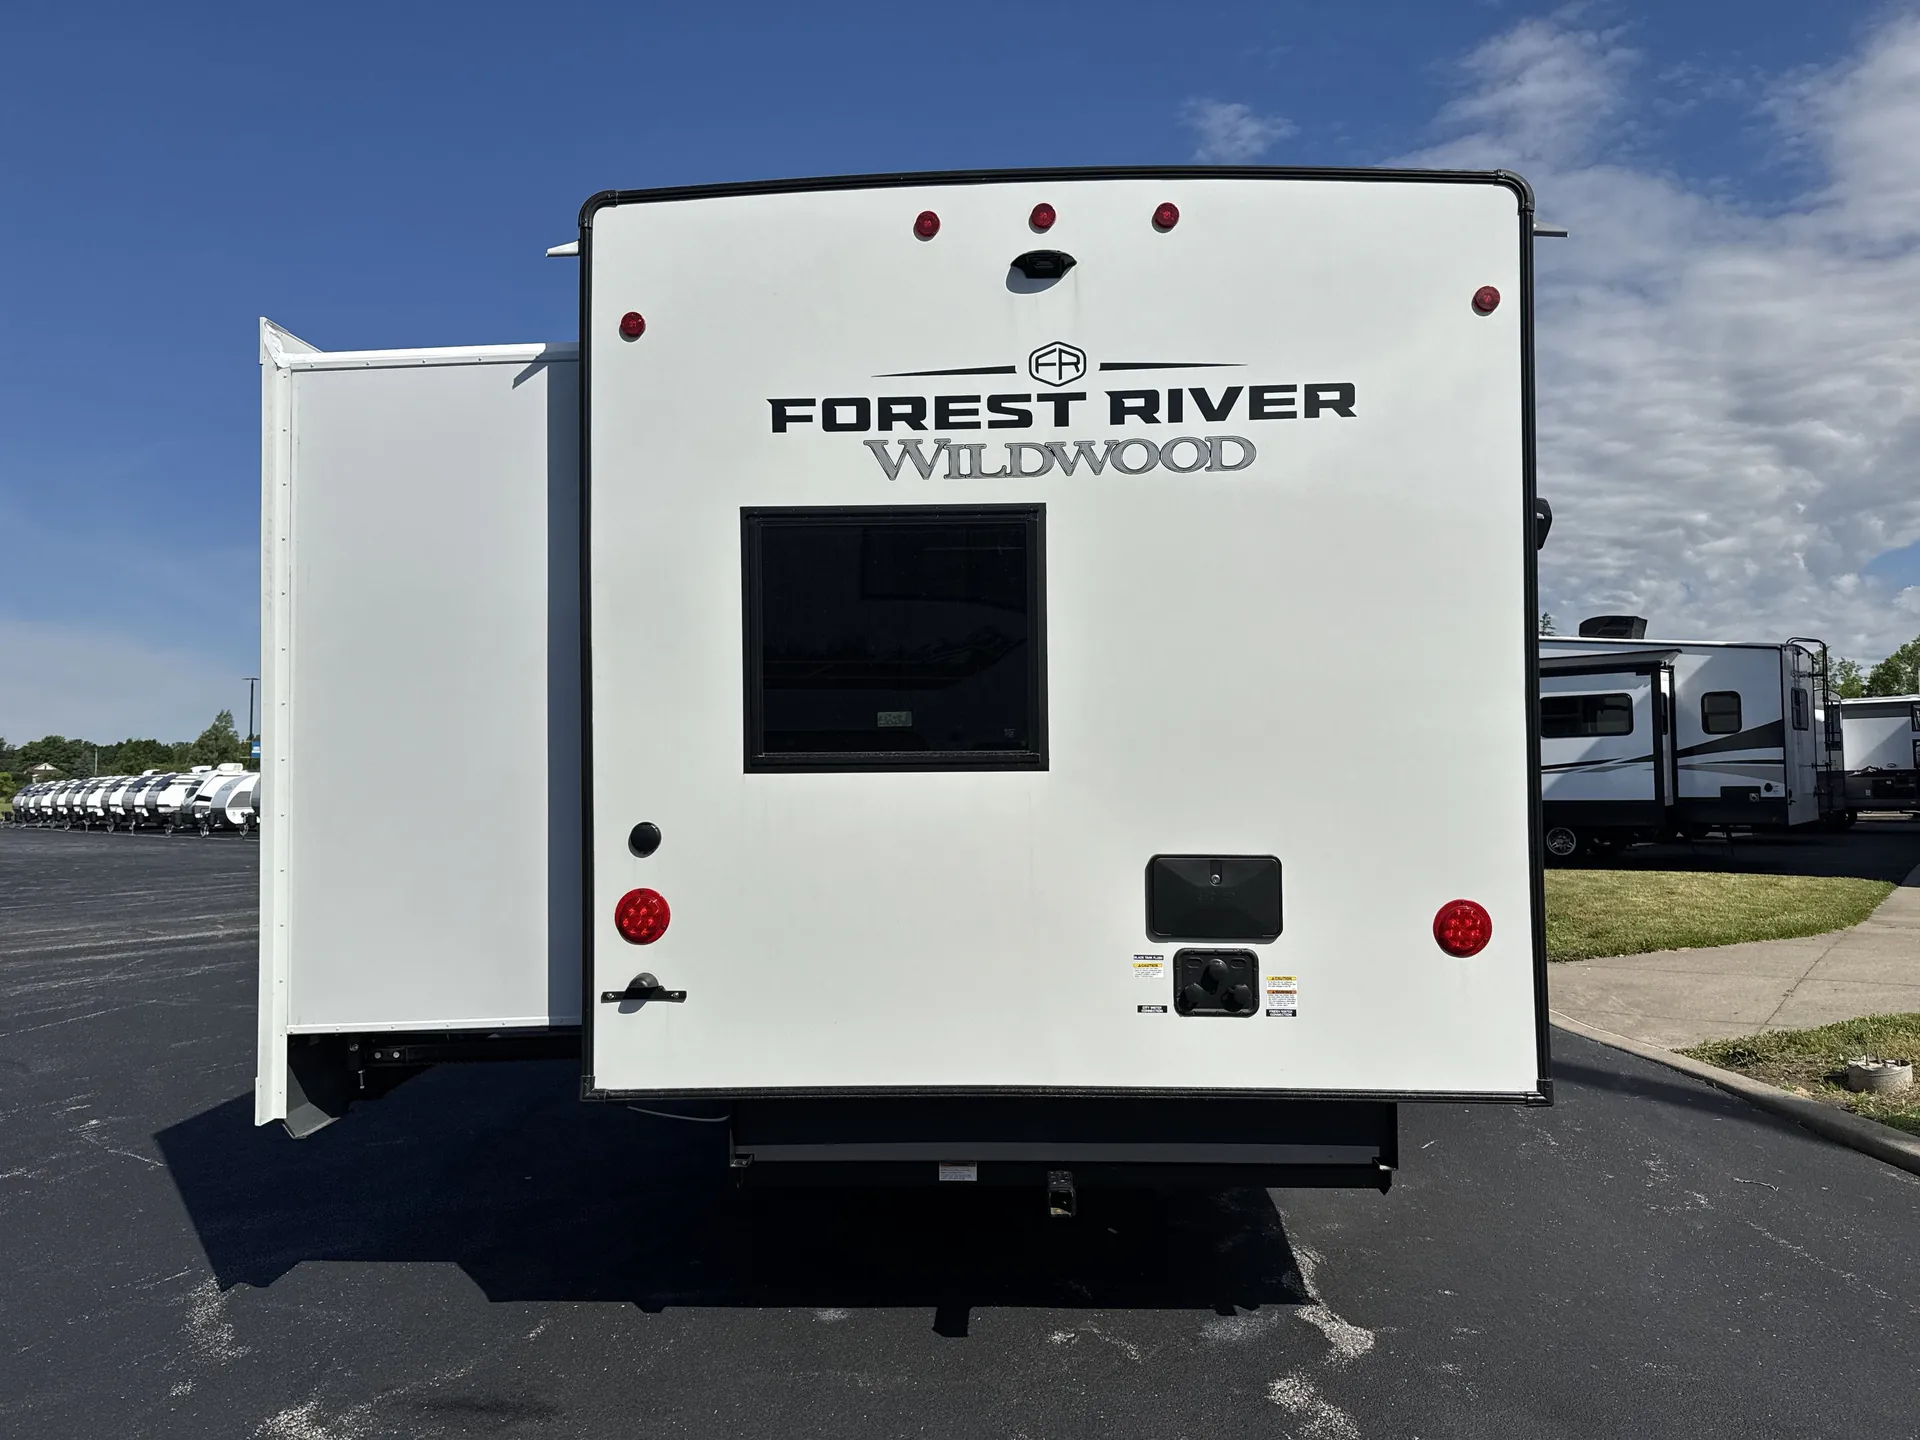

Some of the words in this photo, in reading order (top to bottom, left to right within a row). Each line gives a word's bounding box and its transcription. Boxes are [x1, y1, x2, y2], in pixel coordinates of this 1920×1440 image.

[766, 391, 1087, 433] FOREST
[1104, 382, 1358, 425] RIVER
[863, 435, 1257, 482] WILDWOOD
